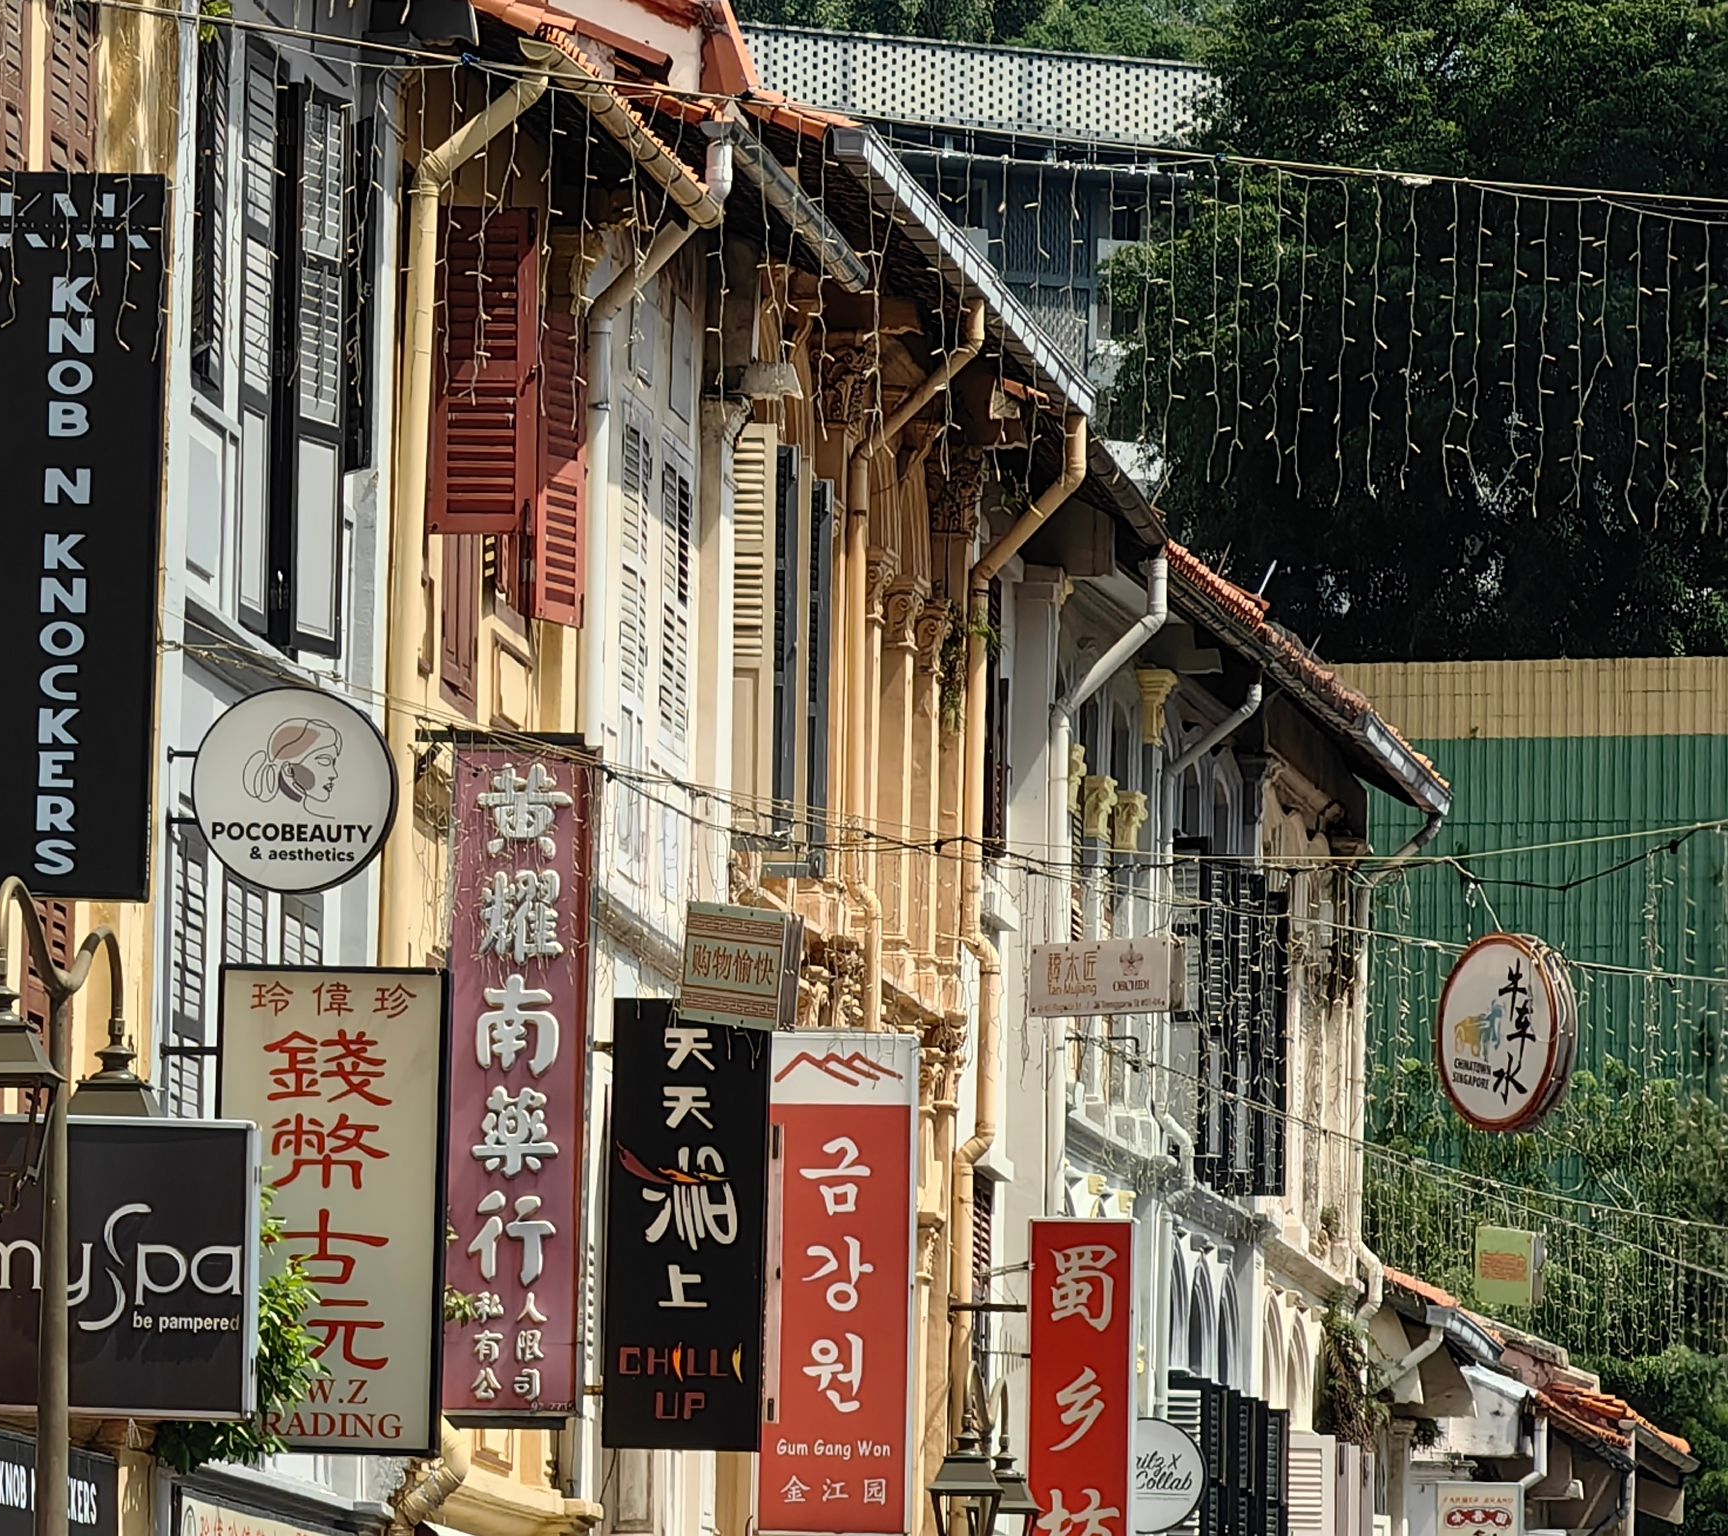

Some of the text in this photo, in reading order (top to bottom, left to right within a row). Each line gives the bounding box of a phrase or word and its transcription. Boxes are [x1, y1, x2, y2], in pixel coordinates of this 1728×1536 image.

[34, 276, 94, 875] KNOB N KNOCKERS
[212, 822, 373, 844] POCOBEAUTY
[249, 846, 355, 863] & aesthetics
[692, 944, 774, 985] 购物愉快
[1493, 957, 1536, 1106] 牛车水
[1452, 1072, 1489, 1090] SINGAPORE
[1454, 1058, 1491, 1076] CHINATOWN
[800, 1136, 874, 1413] 금강원
[132, 1312, 240, 1333] be pampered
[655, 1392, 706, 1420] UP
[260, 1412, 404, 1440] RADING
[776, 1438, 891, 1461] Gum Gang Won
[68, 1476, 97, 1525] KERS
[780, 1473, 888, 1505] 金江园
